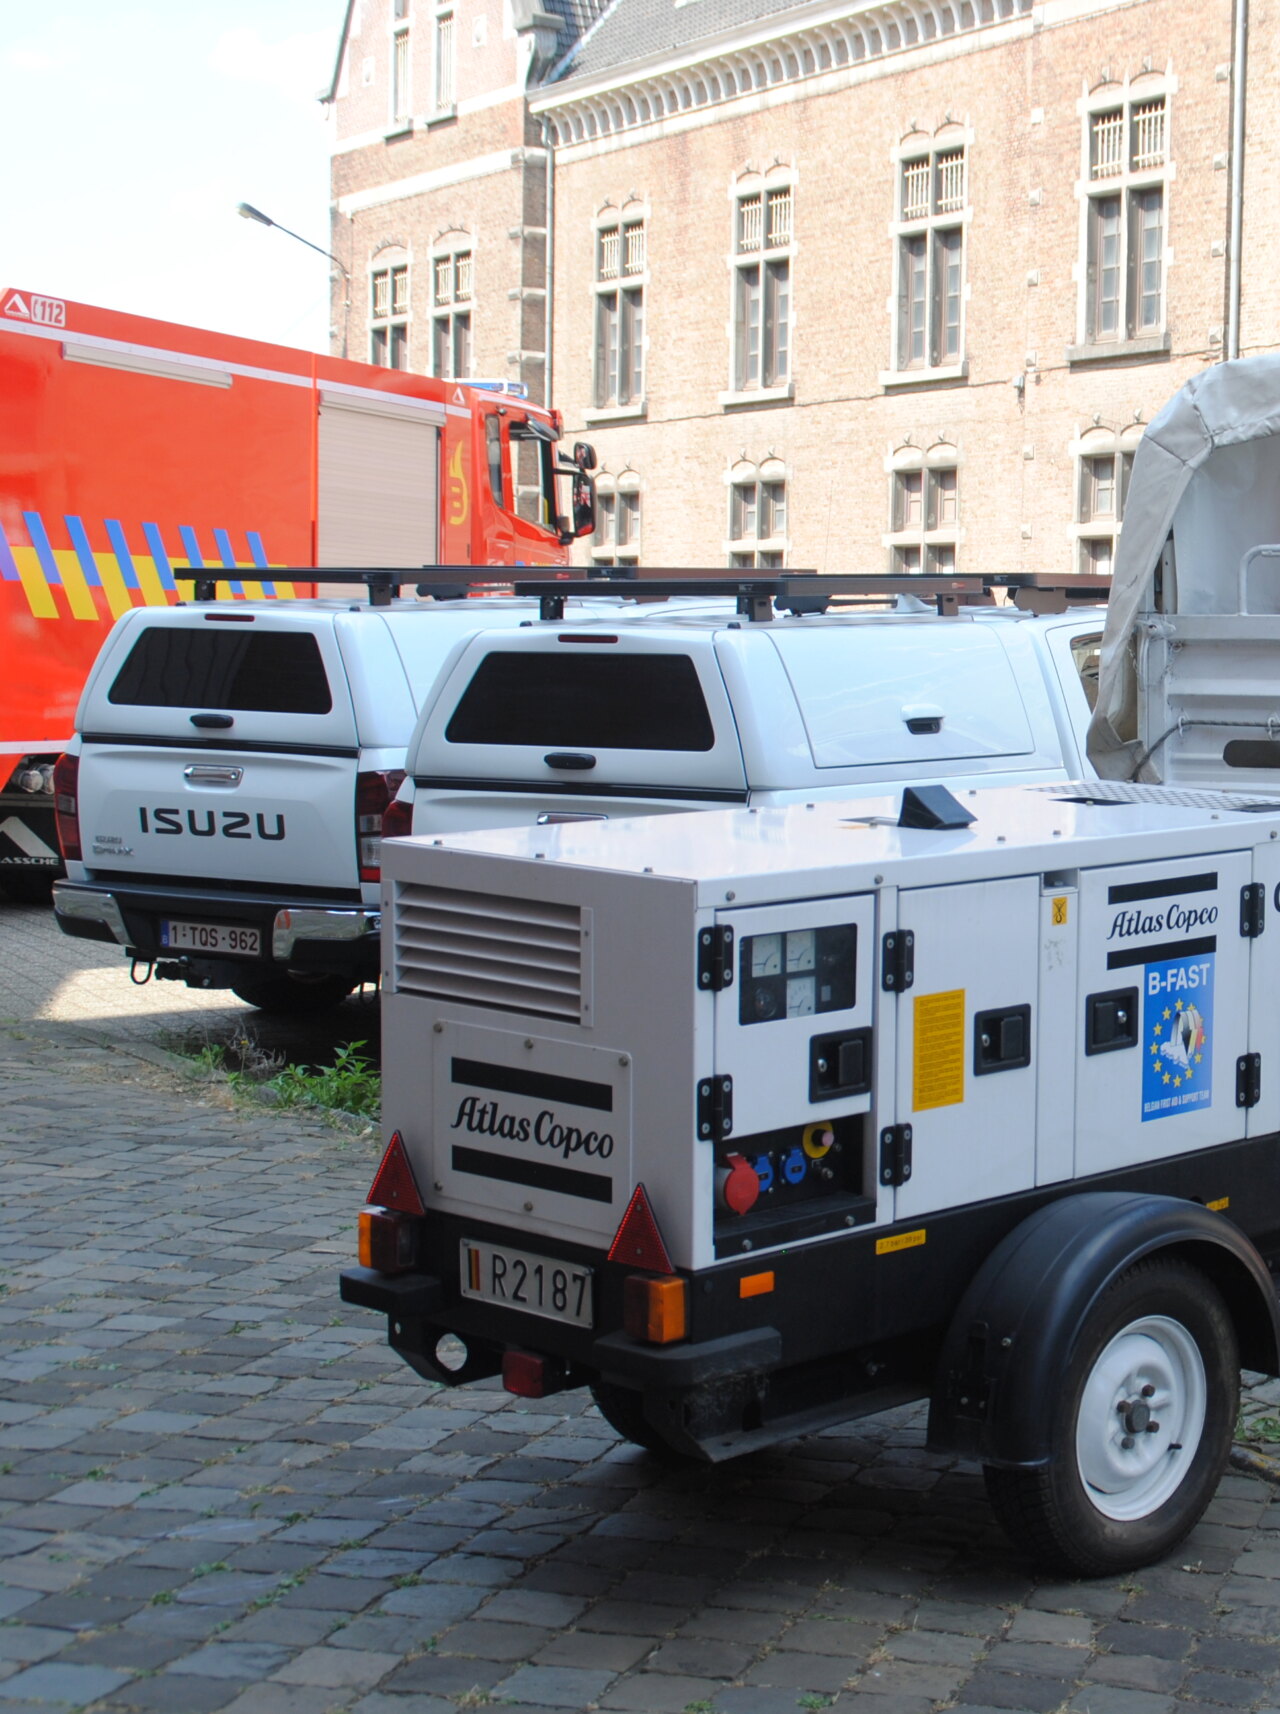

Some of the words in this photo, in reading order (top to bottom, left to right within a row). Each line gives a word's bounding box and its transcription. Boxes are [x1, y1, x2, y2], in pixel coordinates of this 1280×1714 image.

[40, 300, 63, 324] 112
[139, 807, 286, 841] ISUZU
[1106, 910, 1164, 941] Atlas
[1166, 904, 1219, 934] Copco
[1148, 963, 1211, 996] B-FAST
[450, 1096, 531, 1142] Atlas
[534, 1110, 614, 1159] Copco
[492, 1253, 586, 1317] R2187
